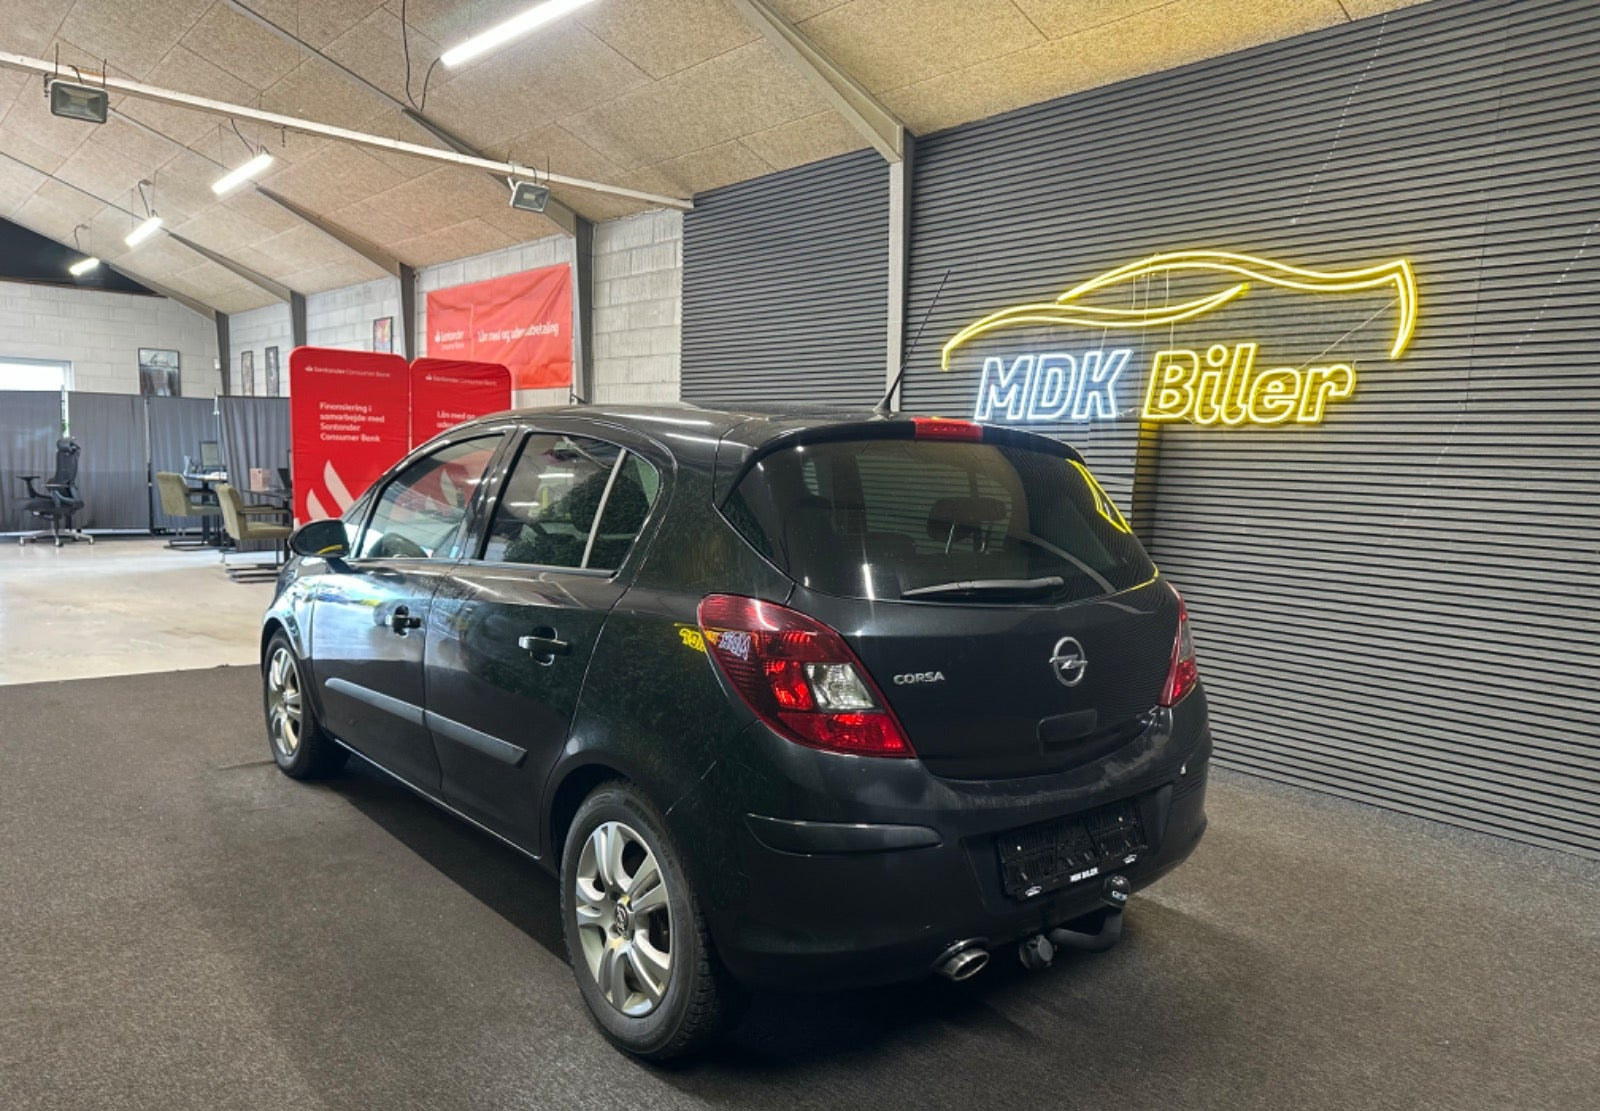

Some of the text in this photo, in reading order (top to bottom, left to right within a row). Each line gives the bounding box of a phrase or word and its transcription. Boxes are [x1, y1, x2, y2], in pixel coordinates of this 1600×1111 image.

[313, 366, 345, 374] Santander
[974, 343, 1357, 425] MDK Biler
[320, 402, 367, 414] Finansiering
[320, 413, 385, 423] samarbejde med
[450, 412, 466, 420] med
[320, 422, 361, 431] Santander
[320, 432, 380, 442] Consumer Bank
[893, 671, 945, 685] CORSA
